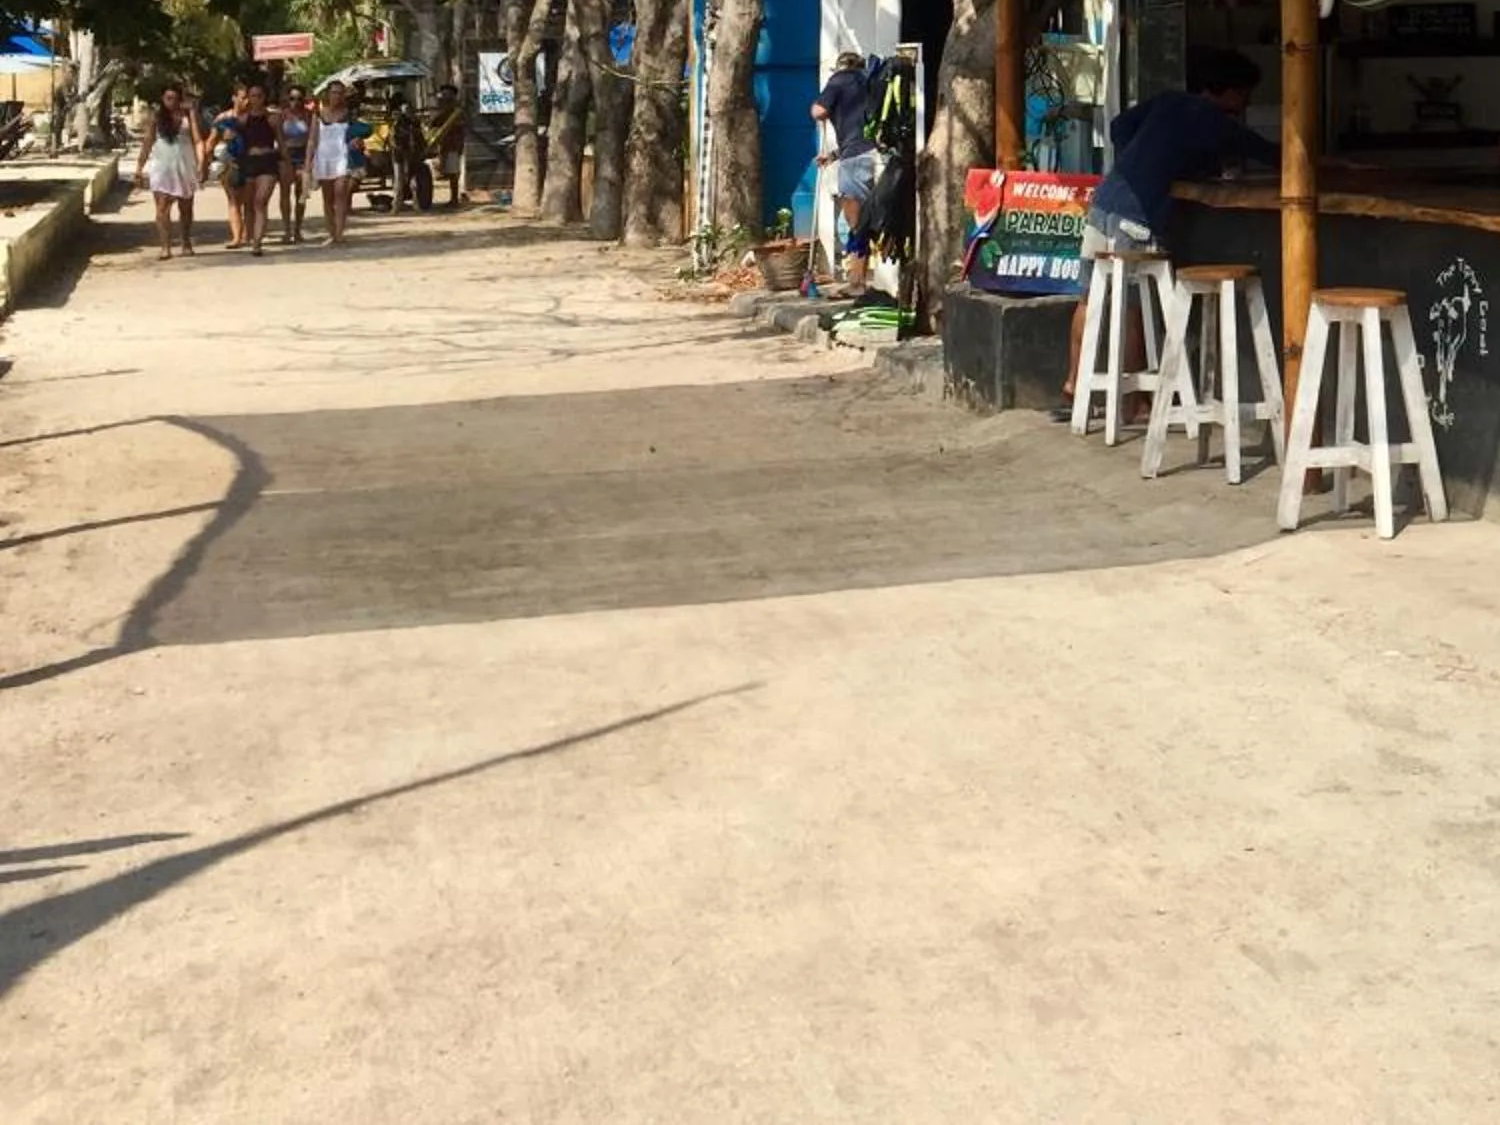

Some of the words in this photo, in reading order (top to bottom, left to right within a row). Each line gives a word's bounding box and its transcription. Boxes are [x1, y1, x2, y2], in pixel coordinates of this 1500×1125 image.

[1013, 182, 1077, 201] WELCOME
[1084, 186, 1096, 203] T
[1005, 208, 1088, 237] PARADI
[997, 254, 1047, 278] HAPPY
[1050, 257, 1081, 280] HOU
